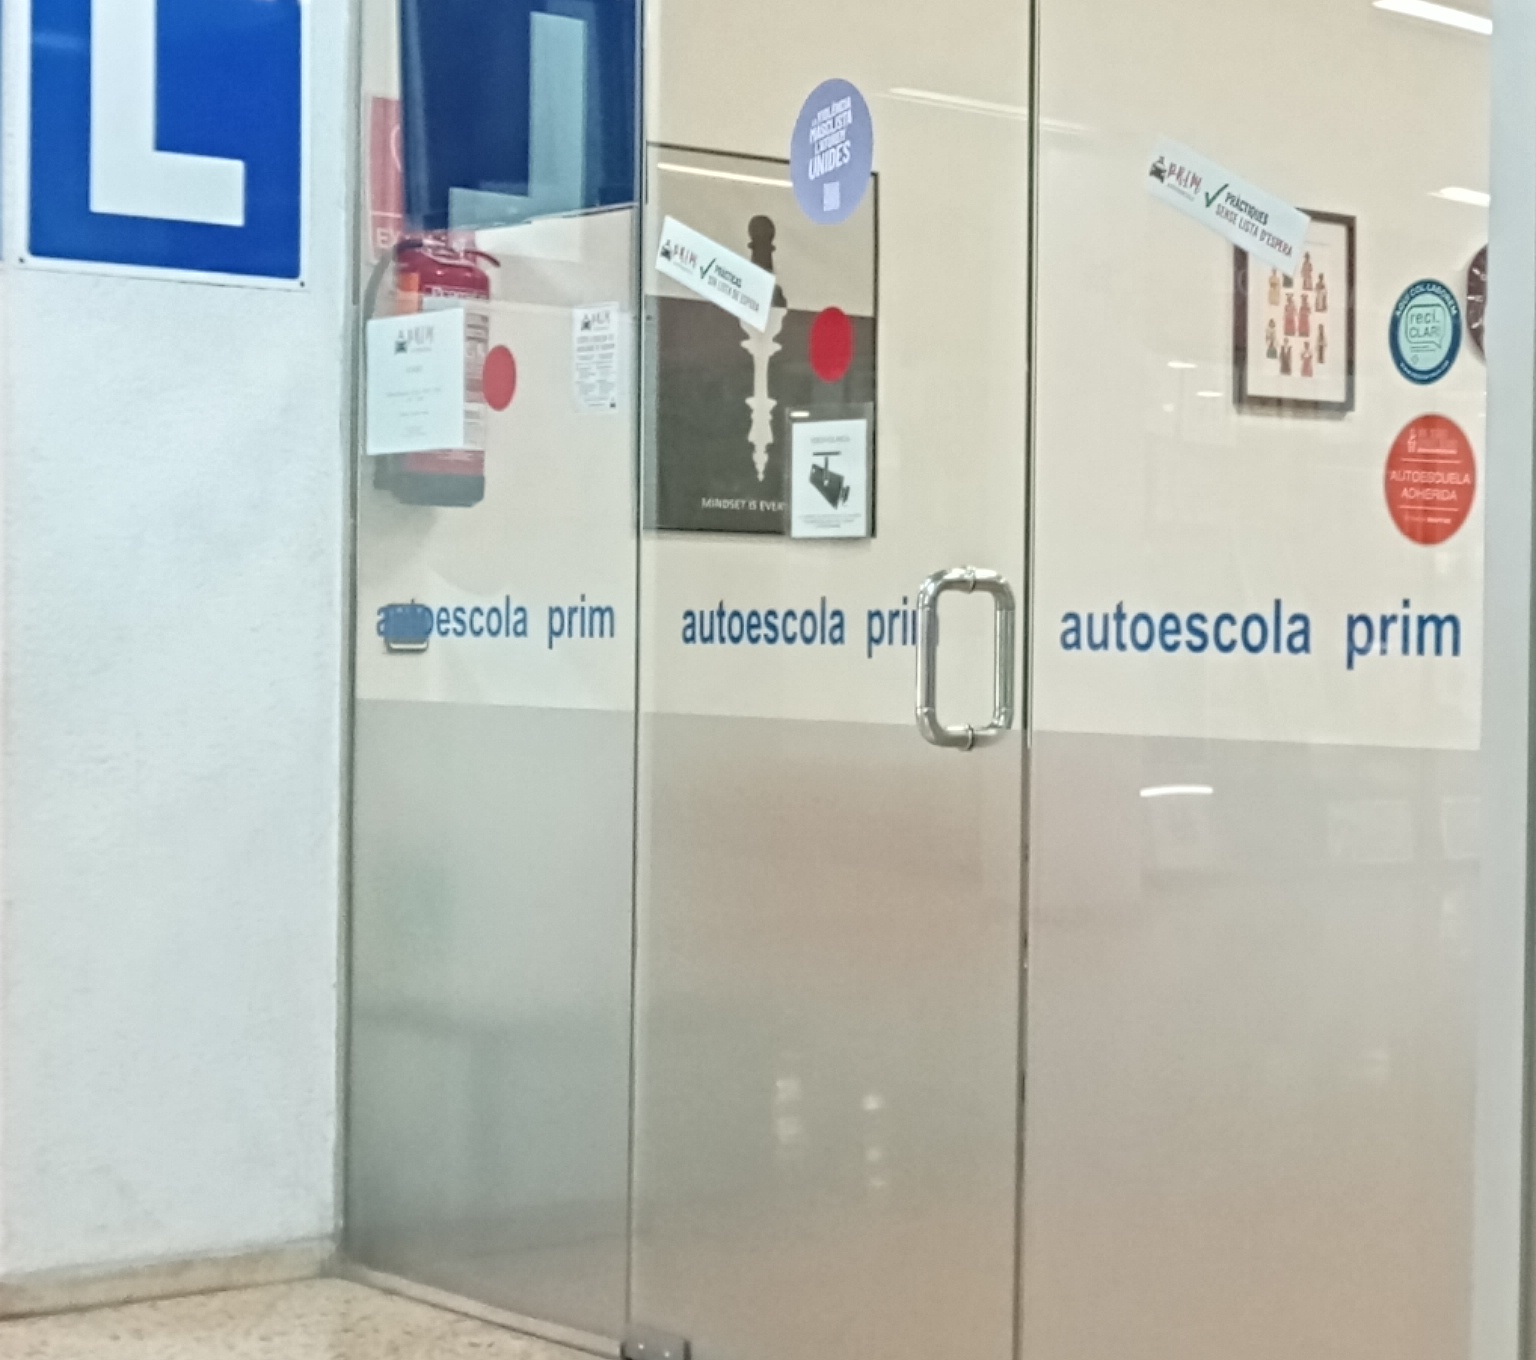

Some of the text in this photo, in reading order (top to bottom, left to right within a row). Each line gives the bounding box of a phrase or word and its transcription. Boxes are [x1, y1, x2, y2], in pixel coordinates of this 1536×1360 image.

[808, 139, 852, 181] UNIDES
[701, 496, 746, 511] MINDSET
[759, 499, 787, 513] EVER
[375, 593, 616, 649] aescola prim
[681, 596, 919, 659] autoescola pri
[1058, 597, 1463, 671] autoescola prim
